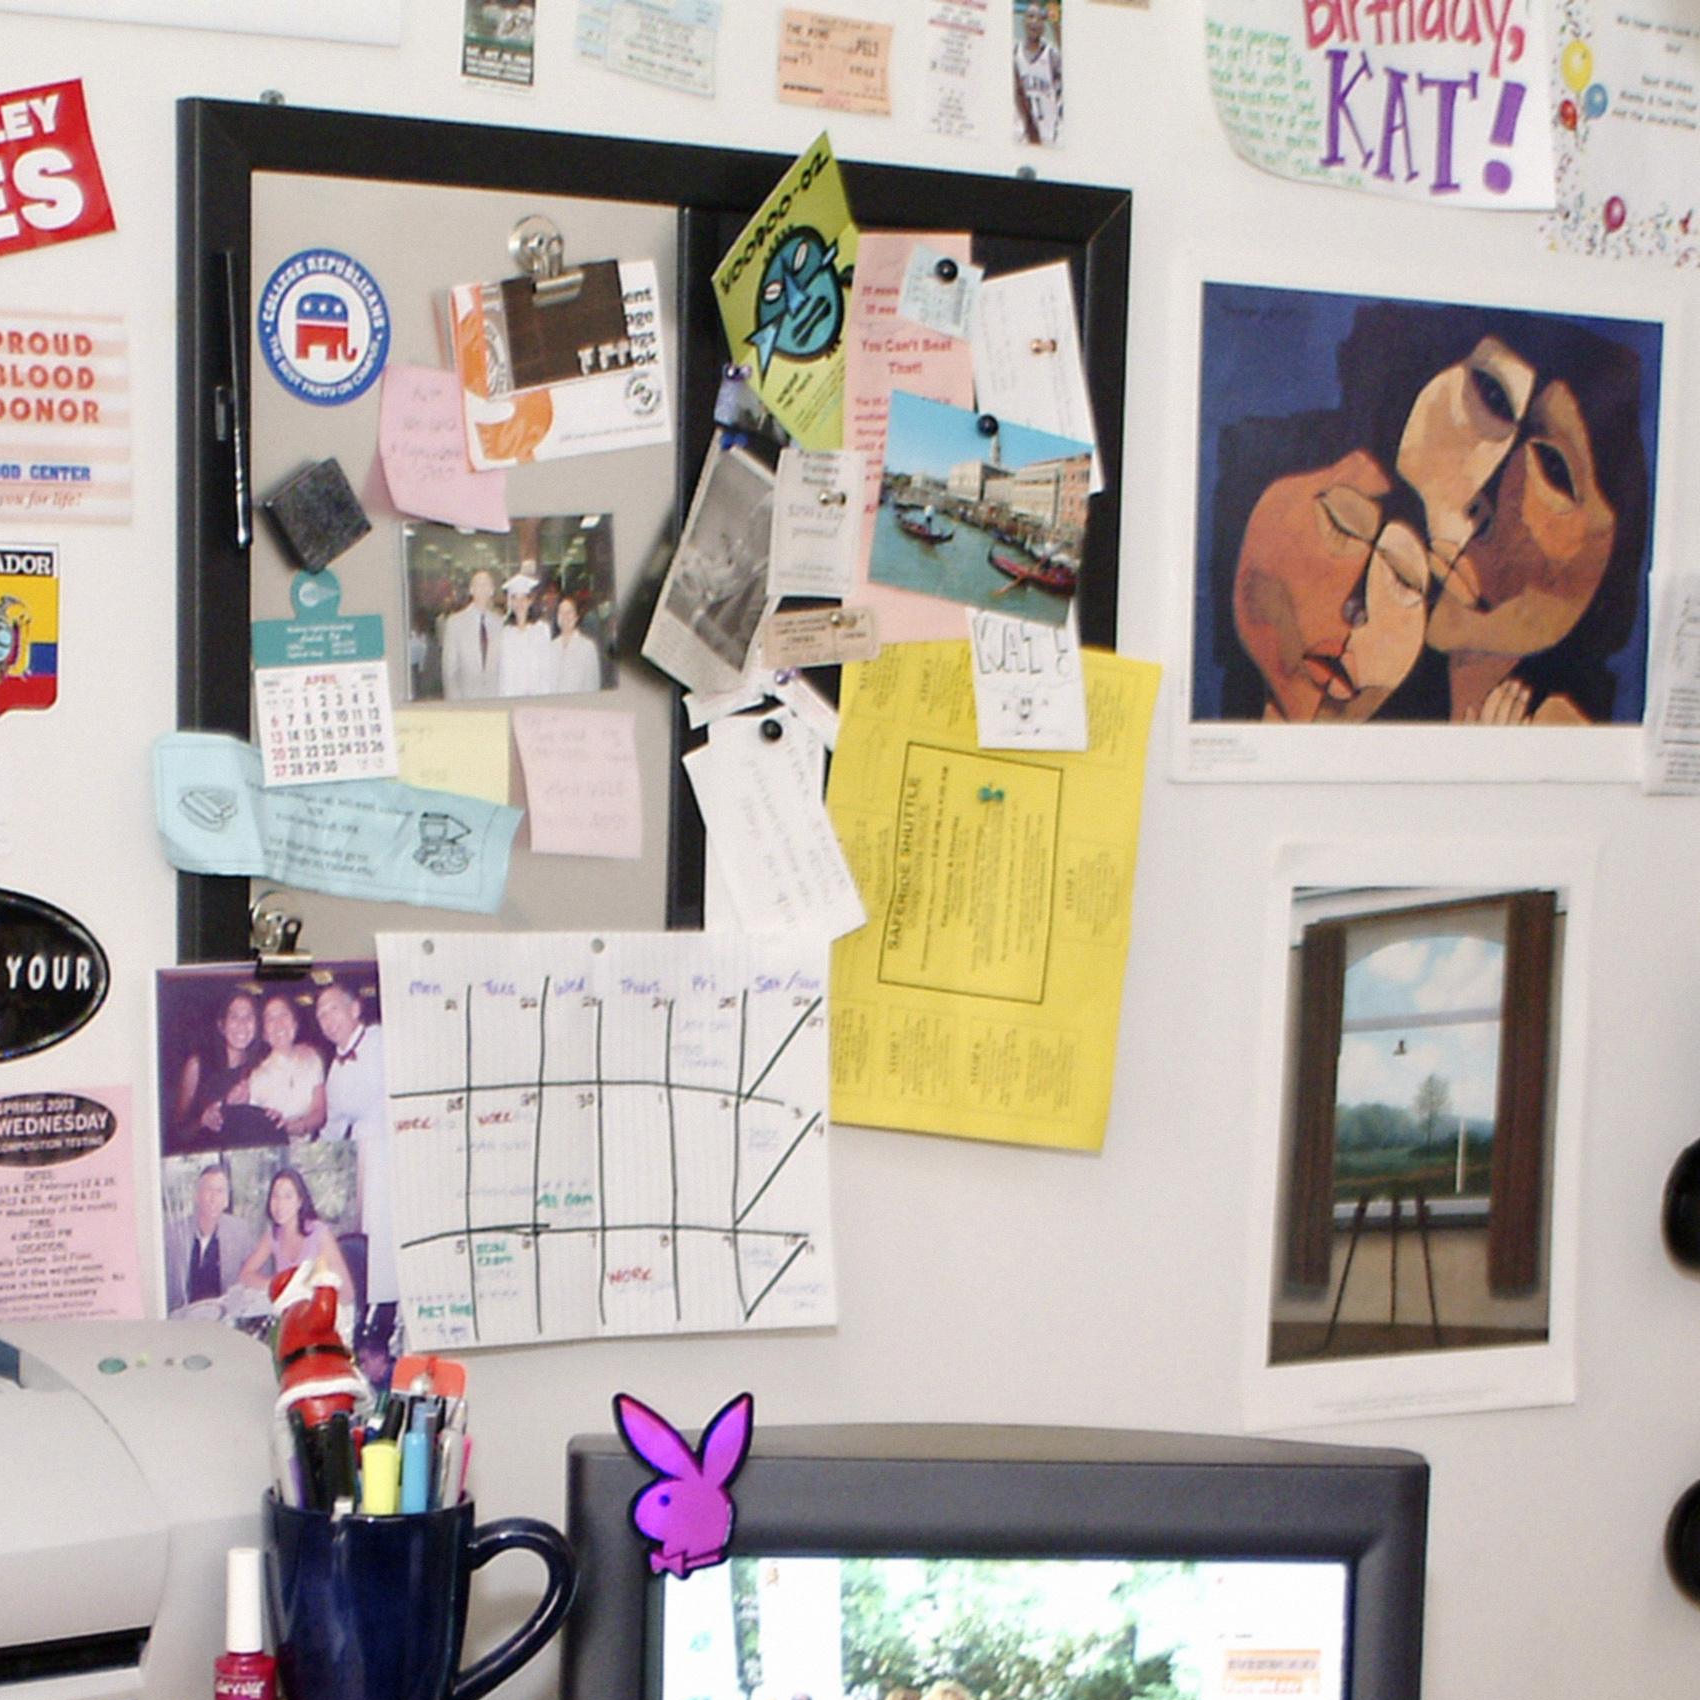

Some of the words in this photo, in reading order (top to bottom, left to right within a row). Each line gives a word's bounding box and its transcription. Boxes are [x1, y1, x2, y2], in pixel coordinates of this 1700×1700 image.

[1320, 48, 1527, 195] KAT!
[261, 260, 306, 322] COLLEGE
[305, 255, 386, 329] REPUBLICANS
[29, 464, 92, 482] CENTER
[25, 492, 49, 512] for
[51, 490, 83, 510] life!
[303, 695, 309, 708] 1
[320, 693, 327, 707] 2
[336, 692, 343, 706] 3
[352, 691, 359, 704] 4
[368, 690, 375, 704] 5
[270, 715, 279, 728] 6
[286, 713, 295, 726] 7
[305, 712, 313, 725] 8
[321, 711, 329, 723] 9
[336, 709, 349, 723] 10
[352, 708, 363, 722] 11
[368, 706, 380, 720] 12
[271, 731, 283, 744] 13
[287, 729, 300, 742] 14
[304, 728, 317, 742] 15
[321, 727, 334, 740] 16
[338, 726, 349, 739] 17
[354, 725, 366, 738] 18
[370, 723, 382, 736] 19
[271, 748, 286, 761] 20
[288, 747, 300, 760] 21
[305, 745, 319, 758] 22
[322, 744, 336, 757] 23
[338, 742, 351, 756] 24
[355, 741, 368, 754] 25
[370, 739, 385, 753] 26
[273, 764, 287, 778] 27
[290, 762, 303, 776] 28
[306, 761, 320, 775] 29
[323, 760, 338, 774] 30
[5, 955, 93, 991] YOUR
[409, 979, 442, 997] Mon
[481, 979, 516, 996] Tues
[554, 975, 586, 997] Wed
[620, 976, 661, 995] Thurs
[691, 973, 717, 991] Fri
